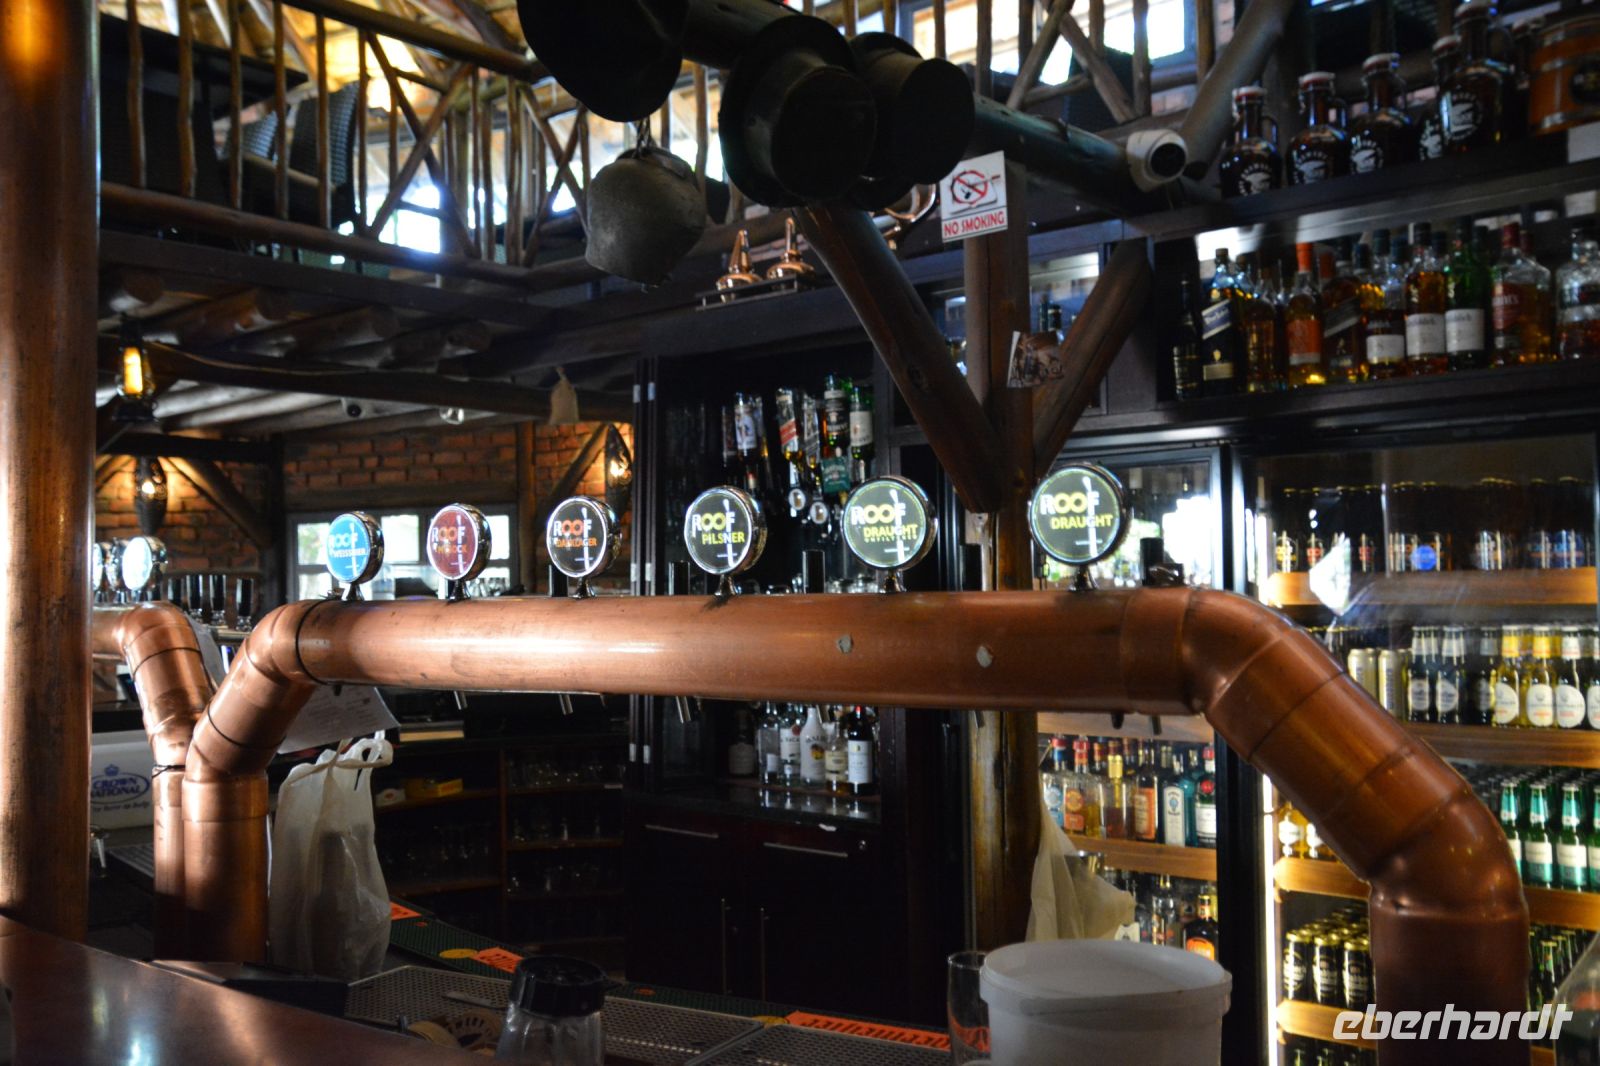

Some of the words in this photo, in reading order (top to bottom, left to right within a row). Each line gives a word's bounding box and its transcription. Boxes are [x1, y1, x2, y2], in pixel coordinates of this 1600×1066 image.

[944, 221, 959, 236] NO
[962, 211, 1005, 232] SMOKING
[1040, 491, 1100, 515] ROOF
[692, 512, 736, 532] ROOF
[850, 503, 906, 525] ROOF
[1050, 514, 1113, 530] DRAUGHT
[432, 526, 466, 544] ROOF
[553, 519, 593, 538] ROOF
[863, 524, 918, 538] DRAUGHT
[327, 532, 359, 549] ROOF
[701, 531, 745, 545] PILSNER
[864, 533, 918, 543] UNFILTRED
[93, 778, 137, 789] CROWN
